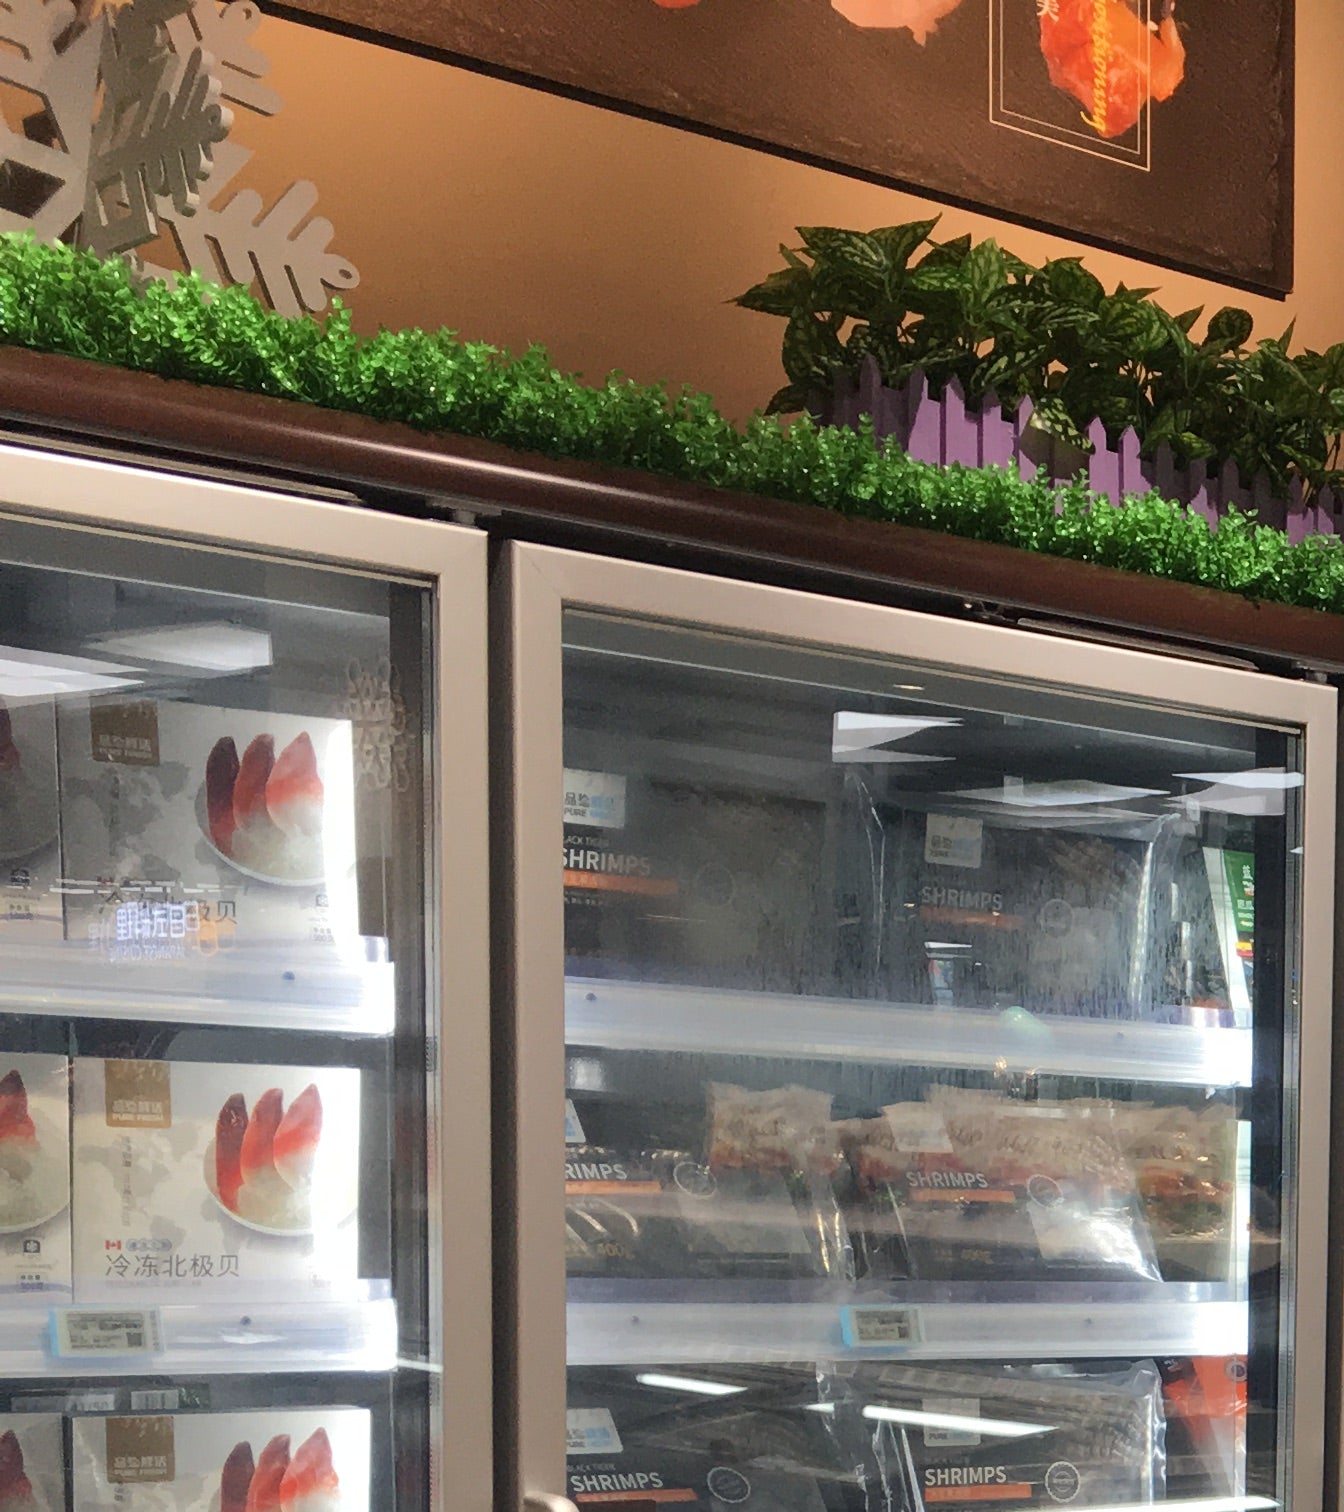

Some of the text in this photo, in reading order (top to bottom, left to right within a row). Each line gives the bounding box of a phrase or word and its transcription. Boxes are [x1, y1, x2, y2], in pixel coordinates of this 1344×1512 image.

[920, 885, 1003, 911] SHRIMPS
[906, 1171, 989, 1189] SHRIMPS
[105, 1254, 240, 1279] 冷冻北极贝
[570, 1471, 664, 1493] SHRIMPS
[924, 1466, 1007, 1487] SHRIMPS
